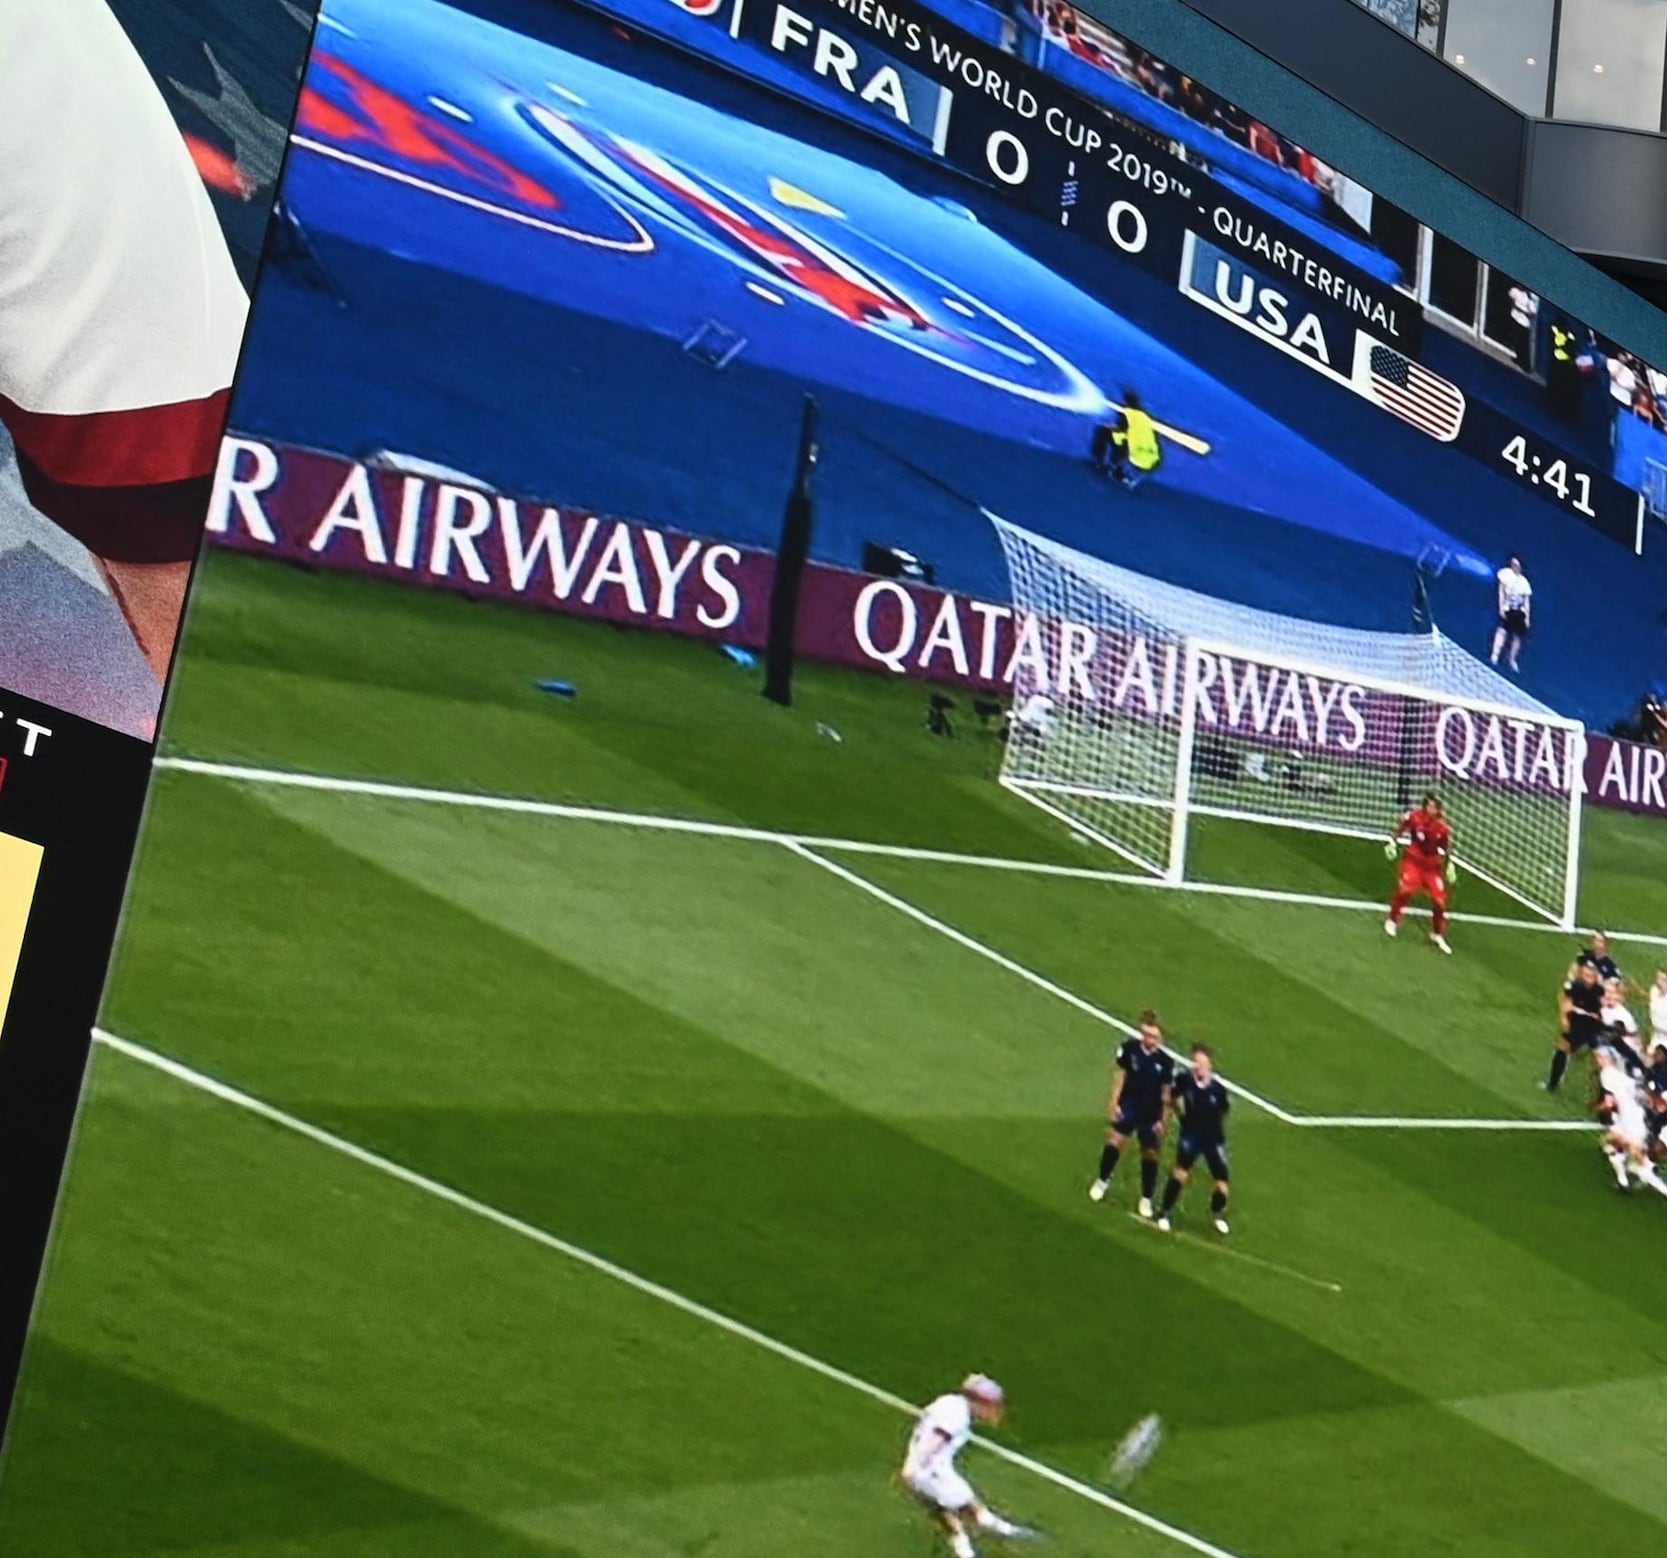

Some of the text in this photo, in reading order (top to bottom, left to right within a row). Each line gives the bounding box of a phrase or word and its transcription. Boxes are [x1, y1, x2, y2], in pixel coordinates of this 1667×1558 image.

[771, 4, 911, 125] FRA
[930, 34, 1037, 119] WORLD
[1045, 107, 1101, 154] CUP
[1213, 207, 1400, 337] QUARTERFINAL
[986, 130, 1029, 185] 0
[1106, 200, 1148, 254] 0
[1214, 261, 1331, 364] USA
[1501, 434, 1595, 518] 4:41
[309, 464, 742, 629] AIRWAYS
[852, 580, 1367, 751] QATAR AIRWAYS
[1434, 707, 1586, 794] QATAR
